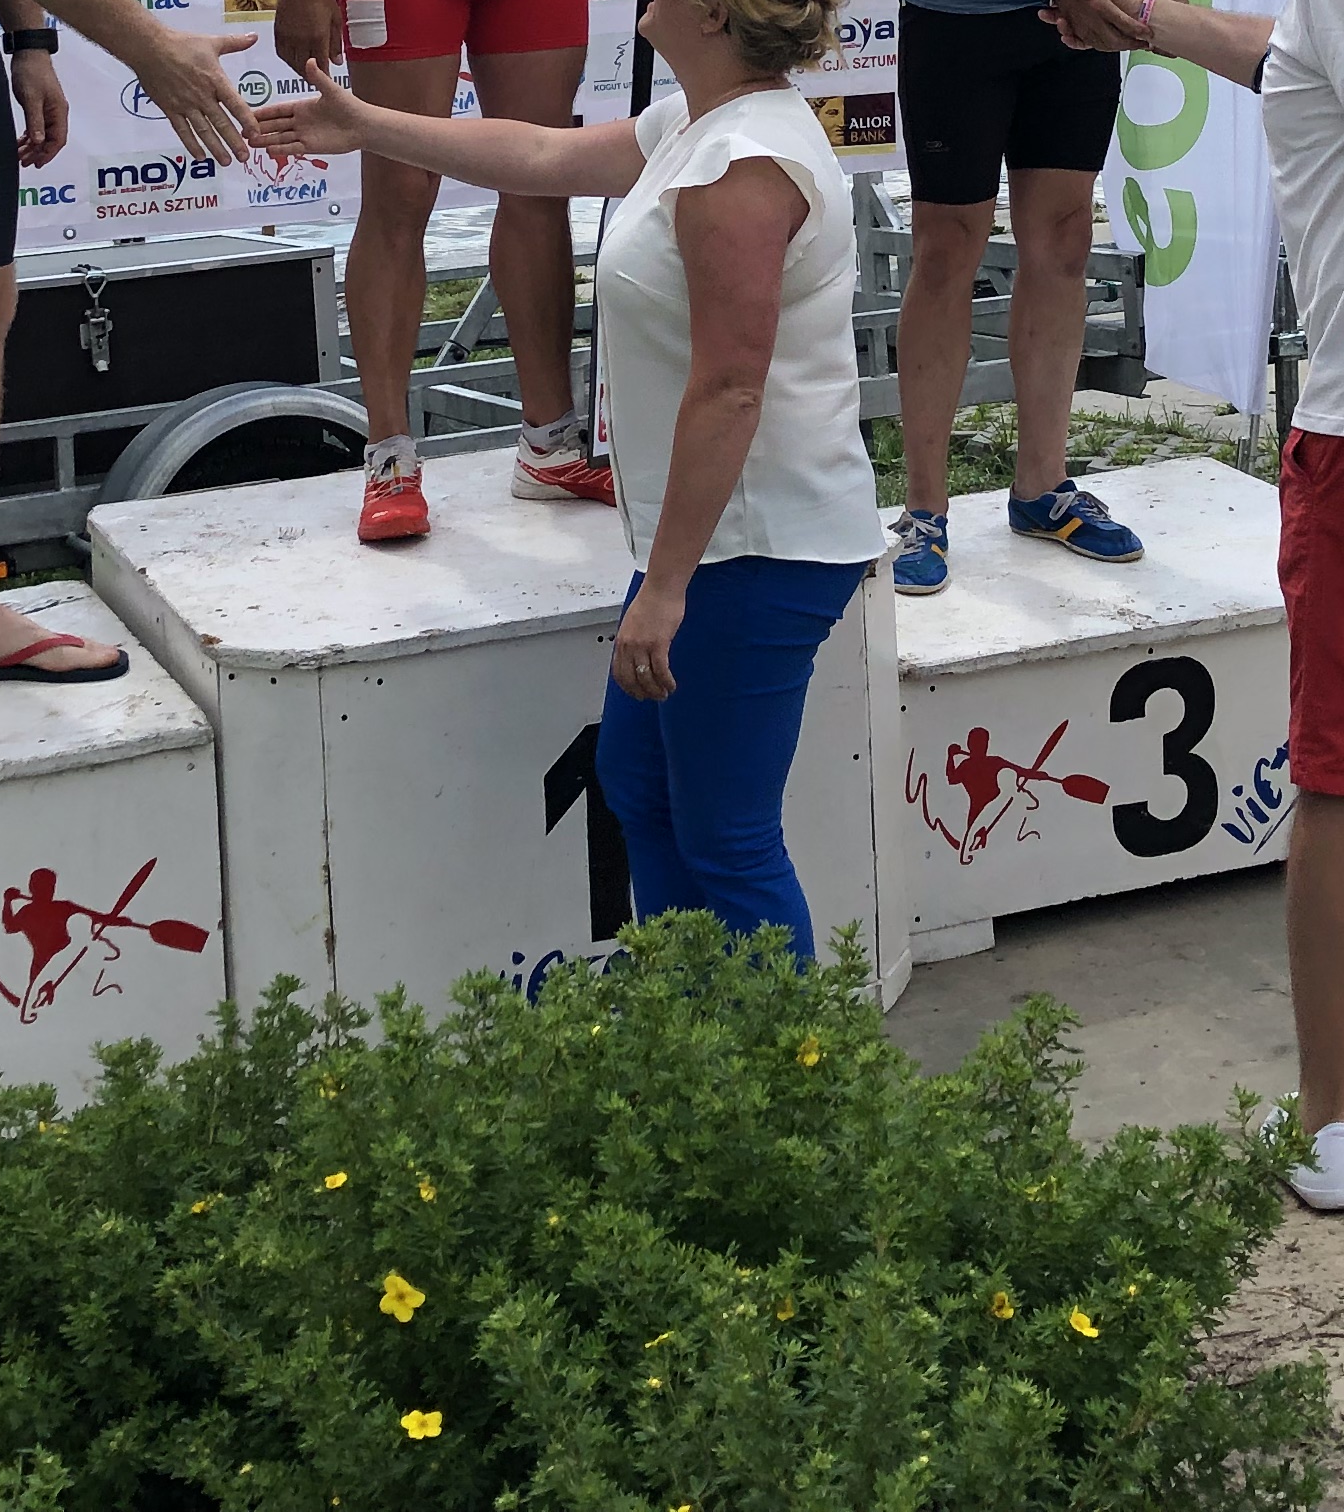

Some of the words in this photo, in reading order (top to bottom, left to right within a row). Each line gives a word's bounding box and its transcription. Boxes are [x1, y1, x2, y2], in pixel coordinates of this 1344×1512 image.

[835, 16, 895, 53] oya
[853, 54, 897, 69] SZTUM
[849, 115, 891, 129] ALIOR
[851, 130, 886, 143] BANK
[98, 155, 216, 195] moya
[19, 184, 76, 207] nac
[97, 201, 159, 219] STACJA
[165, 195, 218, 212] SZTUM
[1108, 655, 1218, 859] 3
[543, 723, 635, 943] 1
